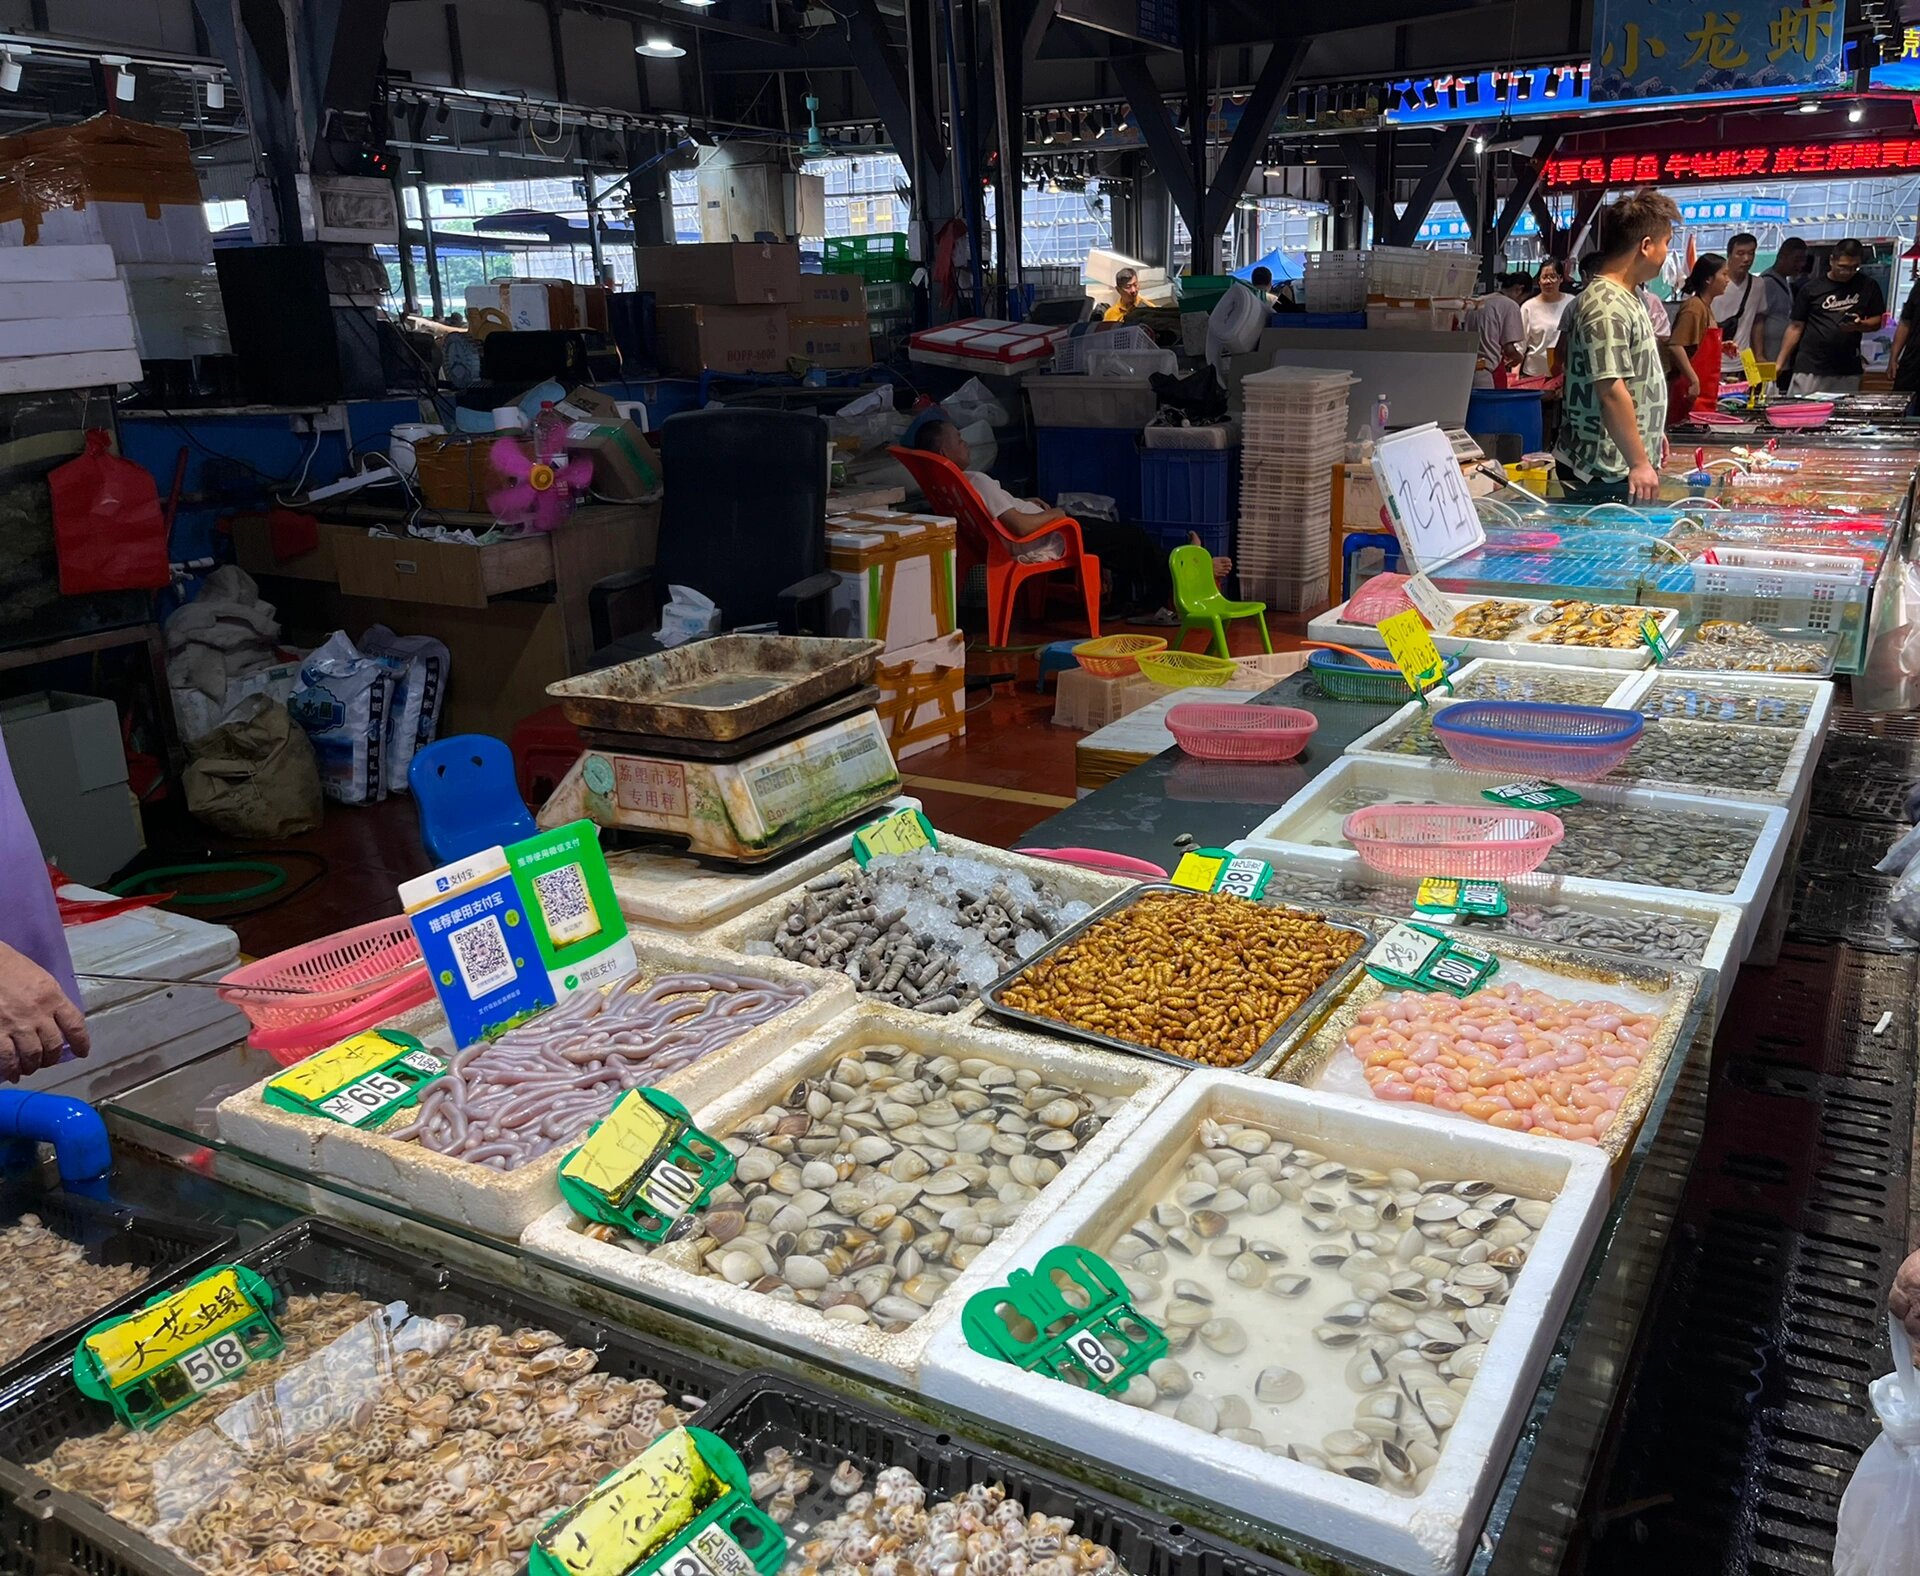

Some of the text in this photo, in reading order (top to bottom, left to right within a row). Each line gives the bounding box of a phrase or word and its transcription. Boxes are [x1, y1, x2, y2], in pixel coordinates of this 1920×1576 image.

[1601, 3, 1837, 78] 小龙虾
[1665, 148, 1769, 178] 牛蛙批发
[516, 837, 581, 868] 推荐使用微信支付
[450, 868, 475, 886] 支付宝
[428, 891, 505, 934] 推荐使用支付宝
[579, 959, 618, 985] 微信支付
[1436, 959, 1472, 984] 80
[646, 1166, 695, 1210] 10
[118, 1285, 245, 1371] 大花螺
[184, 1339, 243, 1385] 58
[1077, 1337, 1115, 1374] 8
